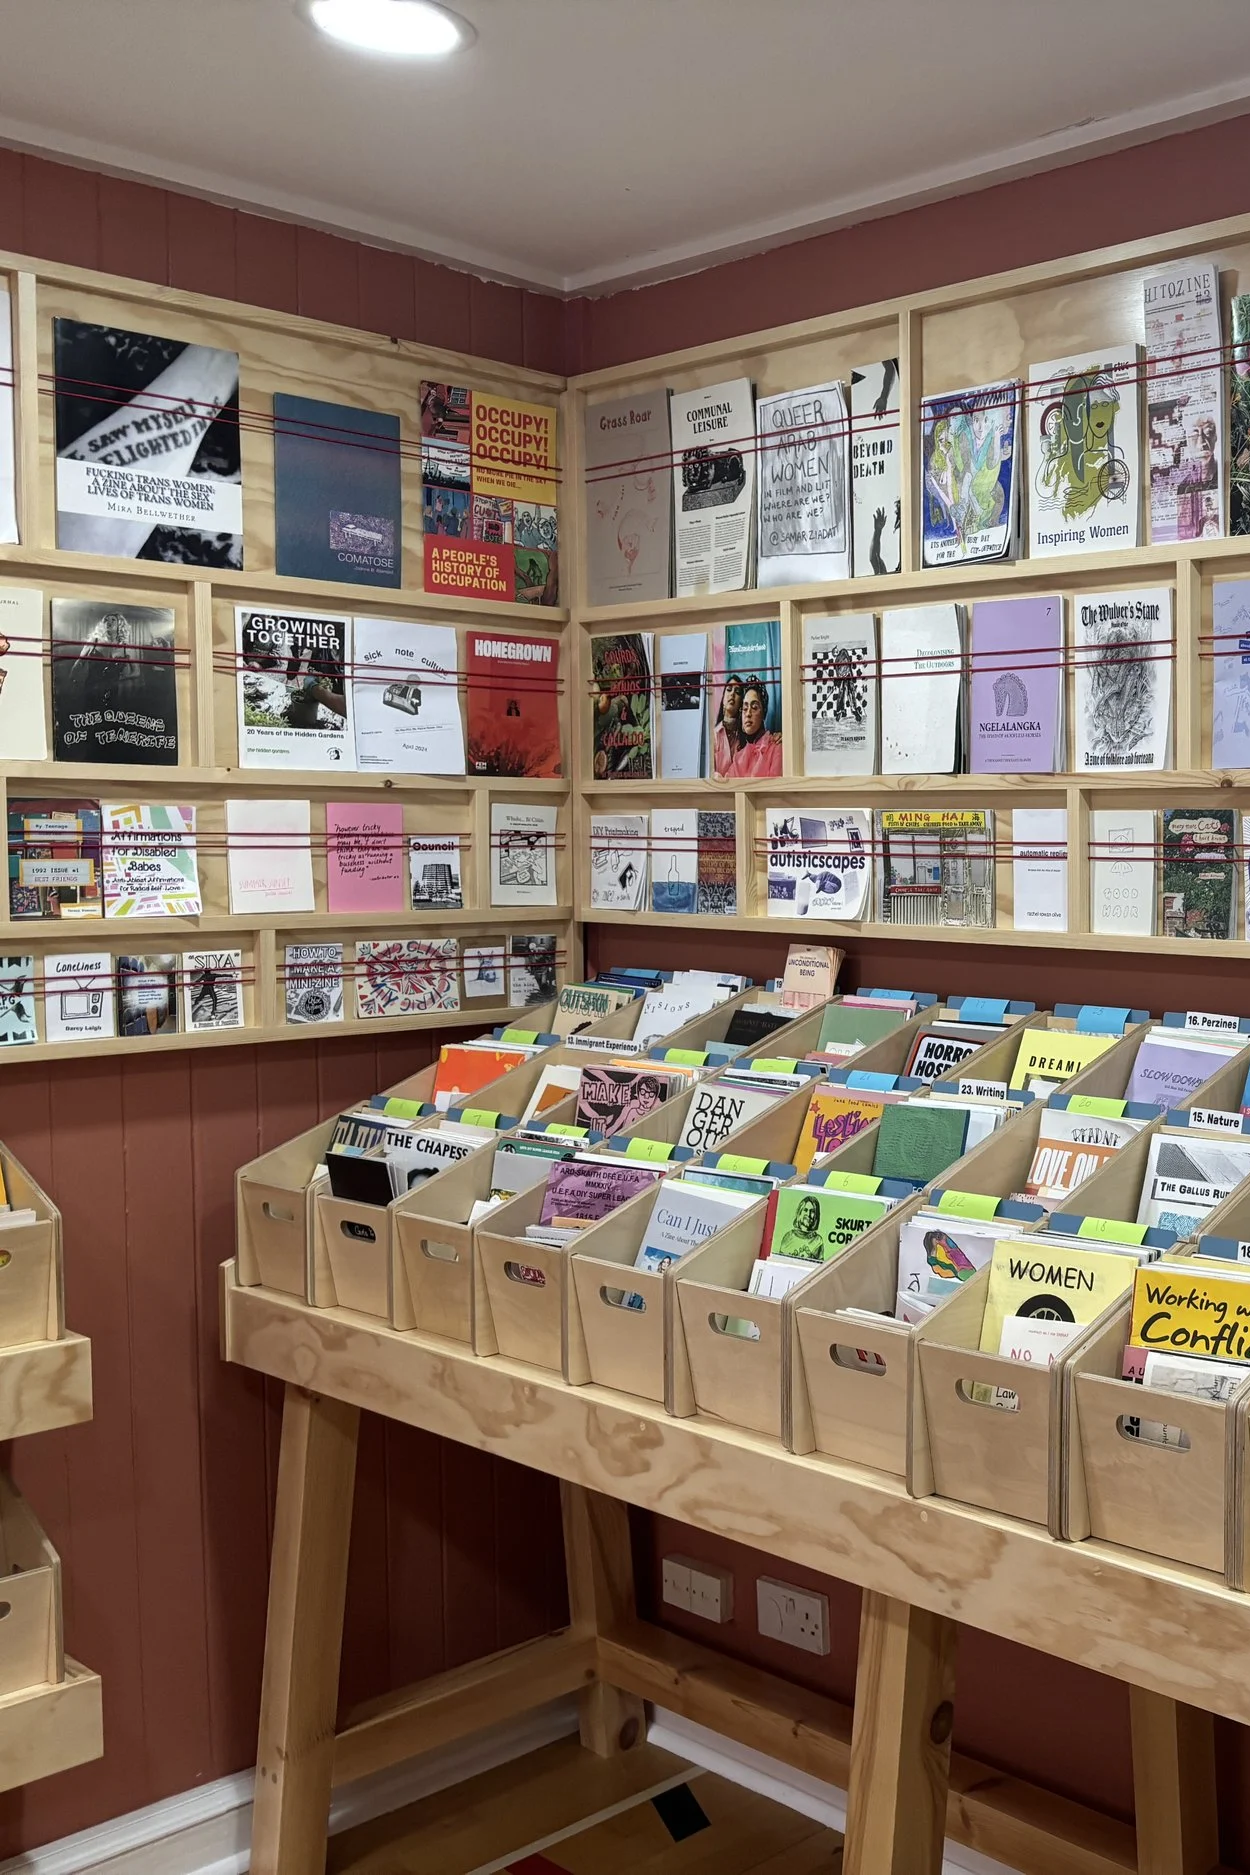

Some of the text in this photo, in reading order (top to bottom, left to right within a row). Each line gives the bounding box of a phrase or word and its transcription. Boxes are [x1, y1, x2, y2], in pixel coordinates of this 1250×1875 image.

[475, 404, 549, 427] OCCUPY!
[600, 409, 652, 430] Grass Roar
[686, 402, 732, 424] COMMUNAL
[772, 400, 826, 429] QUEER
[692, 417, 729, 436] LEISURE
[88, 425, 130, 453] SAW
[475, 424, 549, 452] OCCUPY!
[852, 438, 894, 460] BEYOND
[84, 467, 170, 488] FUCKING TRANS
[772, 457, 830, 484] WOMEN
[852, 460, 886, 480] DEATH
[87, 485, 214, 512] LIVES OF TRANS WOMEN
[129, 483, 210, 502] ABOUT THE SEX
[775, 484, 813, 498] FILM AND
[764, 496, 811, 512] WHERE ARE
[786, 510, 802, 520] ARE
[1037, 524, 1129, 547] Inspiring Women
[338, 552, 394, 568] COMATOSE
[442, 549, 498, 566] PEOPLE'S
[432, 560, 500, 577] HISTORY OF
[432, 573, 506, 592] OCCUPATION
[251, 615, 337, 637] GROWING
[1081, 604, 1098, 628] The
[246, 630, 341, 653] TOGETHER
[474, 638, 552, 663] HOMEGROWN
[364, 647, 449, 677] sick note culture
[979, 722, 1042, 733] NGELALANGKA
[898, 812, 932, 822] MING
[132, 847, 177, 858] Disabled
[770, 851, 866, 874] autisticscapes
[1019, 850, 1048, 858] automatic
[128, 860, 162, 872] Babes
[56, 960, 102, 973] Loneliness
[788, 958, 829, 970] UNCONDITIONAL
[799, 968, 815, 978] BEING
[1188, 1015, 1239, 1030] 16. Perzines
[575, 1038, 638, 1053] Immigrant Experience
[582, 1080, 632, 1105] MAKE
[961, 1084, 1005, 1100] 23. Writing
[696, 1092, 746, 1120] DAN
[1192, 1112, 1240, 1128] 15. Nature
[386, 1130, 470, 1160] THE CHAPESS
[1160, 1182, 1176, 1193] THE
[657, 1208, 692, 1230] Can I
[836, 1218, 873, 1232] SKURT
[1008, 1258, 1094, 1292] WOMEN
[1146, 1282, 1227, 1322] Working
